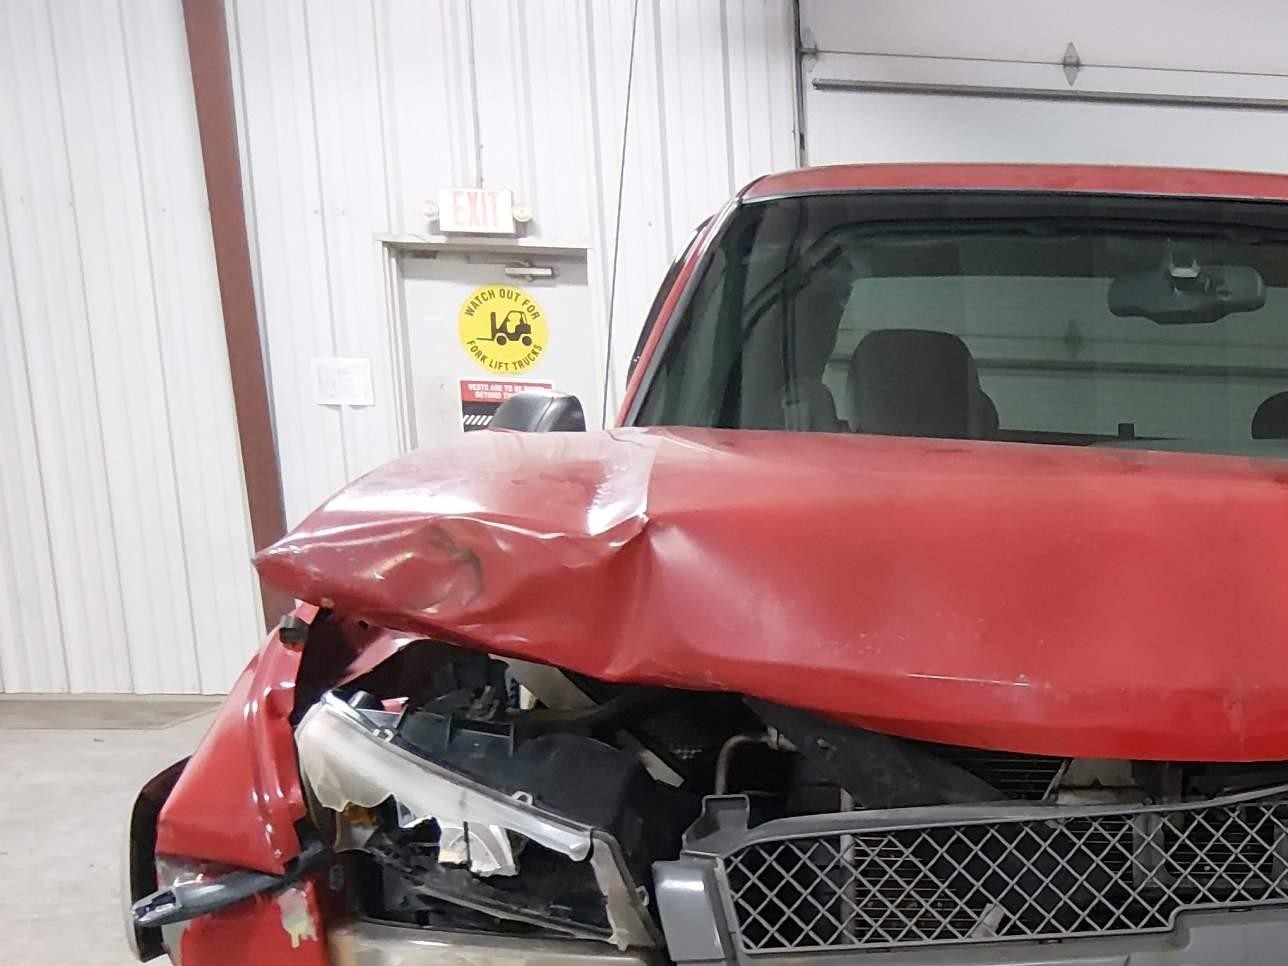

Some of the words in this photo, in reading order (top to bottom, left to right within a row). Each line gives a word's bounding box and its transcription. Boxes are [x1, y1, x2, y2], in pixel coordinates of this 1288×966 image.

[452, 191, 498, 226] EXIT
[465, 289, 496, 317] WATCH
[499, 288, 521, 303] OUT
[521, 299, 540, 320] FOR
[466, 340, 488, 364] FORK
[488, 358, 509, 371] LIFT
[513, 344, 543, 371] TRUCKS
